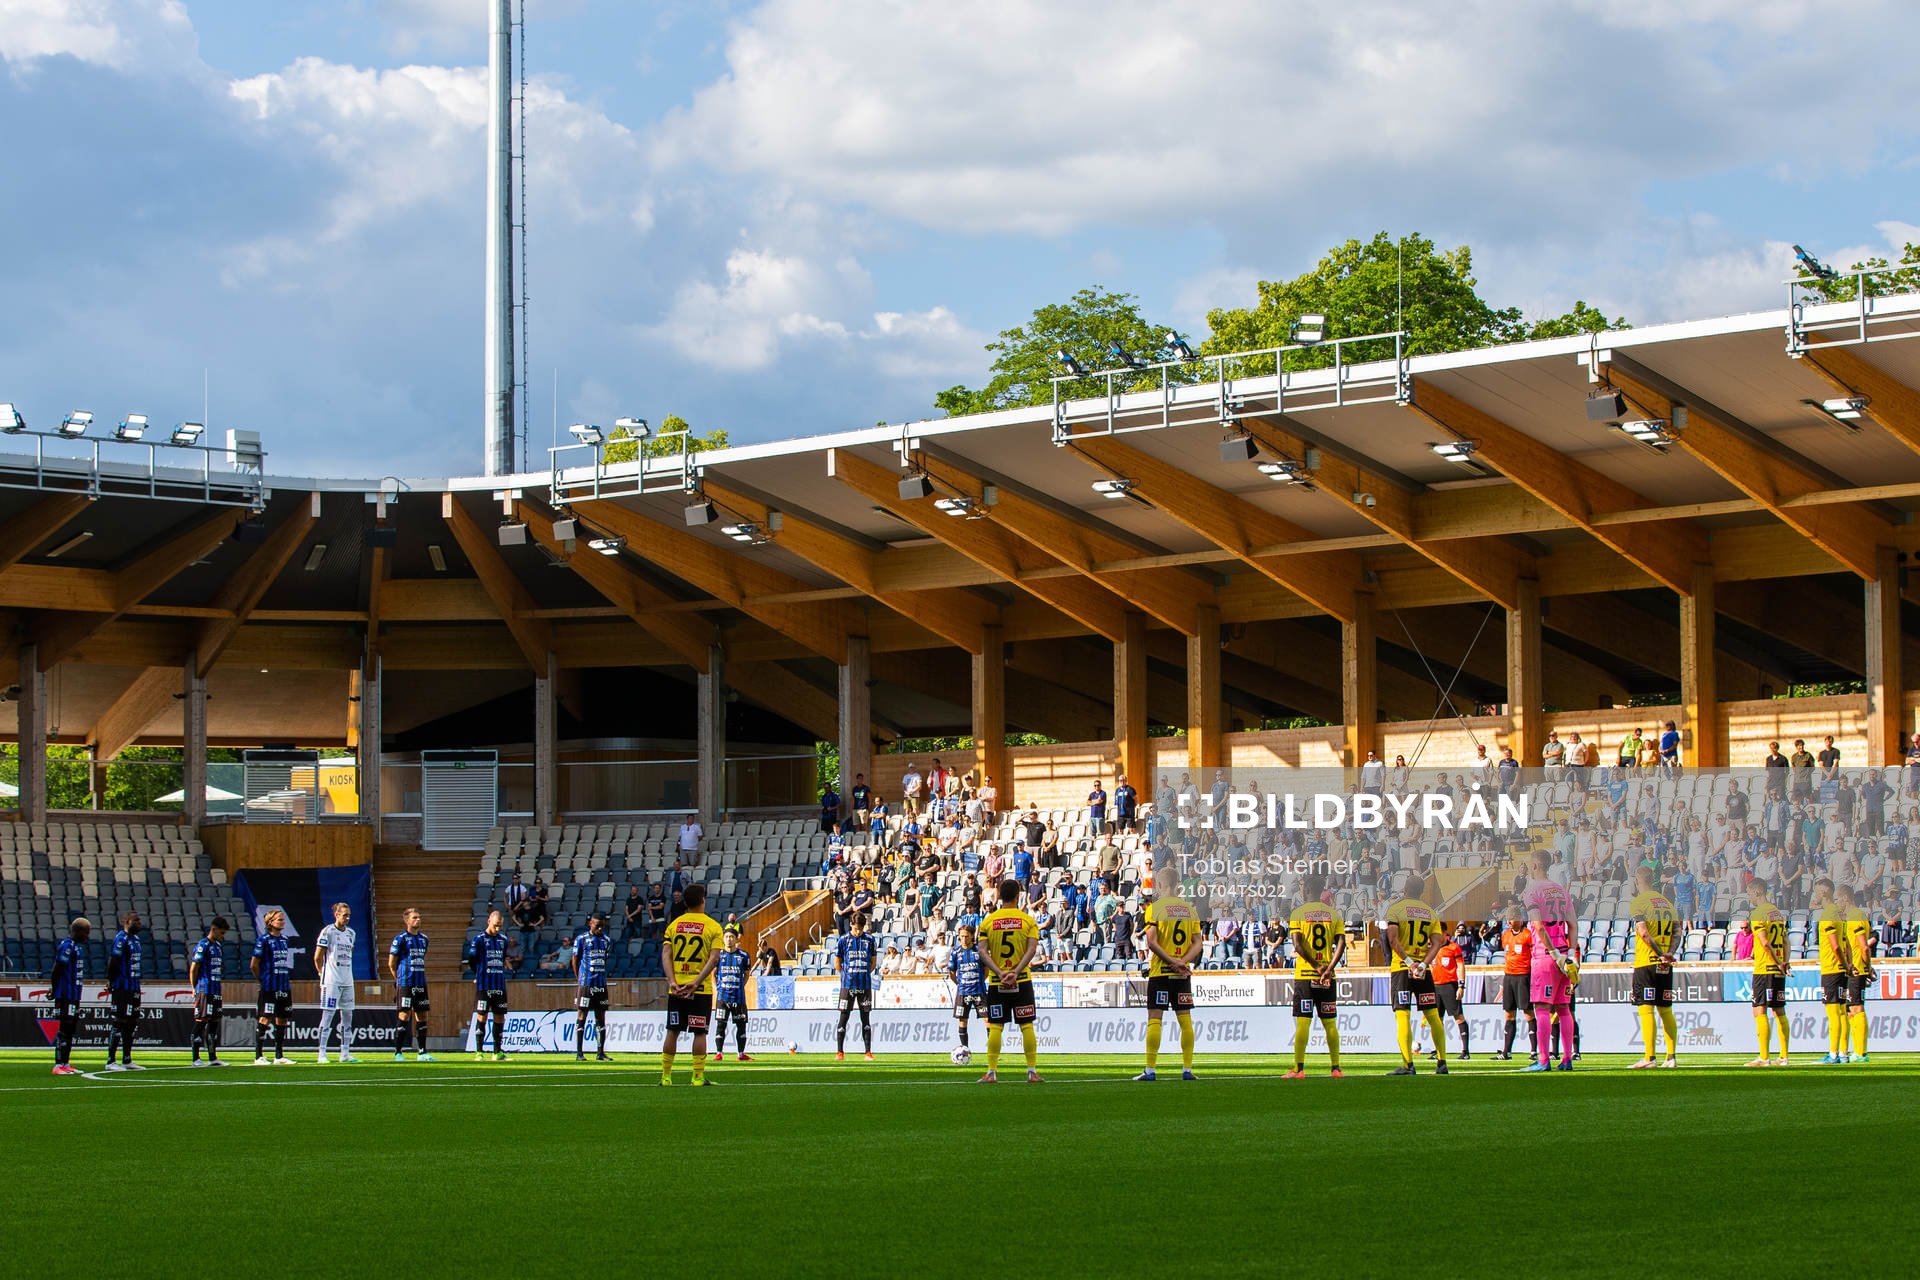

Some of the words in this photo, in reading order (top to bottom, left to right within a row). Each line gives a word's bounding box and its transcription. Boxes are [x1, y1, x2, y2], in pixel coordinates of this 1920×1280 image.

[329, 774, 354, 786] KIOSK
[1173, 918, 1187, 946] 6
[1313, 924, 1327, 951] 8
[1408, 920, 1431, 947] 15
[674, 935, 704, 962] 22
[1000, 931, 1015, 958] 5
[1196, 985, 1255, 1001] ByggPartner
[1284, 981, 1353, 999] NIC
[94, 1008, 109, 1019] EL
[147, 1008, 163, 1019] AB
[627, 1022, 656, 1042] MED
[747, 1017, 778, 1033] iBRO
[808, 1022, 821, 1042] VI
[880, 1022, 910, 1042] MED
[912, 1022, 951, 1042] STEEL
[1088, 1022, 1100, 1042] VI
[1105, 1018, 1136, 1042] GÖR
[1206, 1021, 1249, 1042] STEEL
